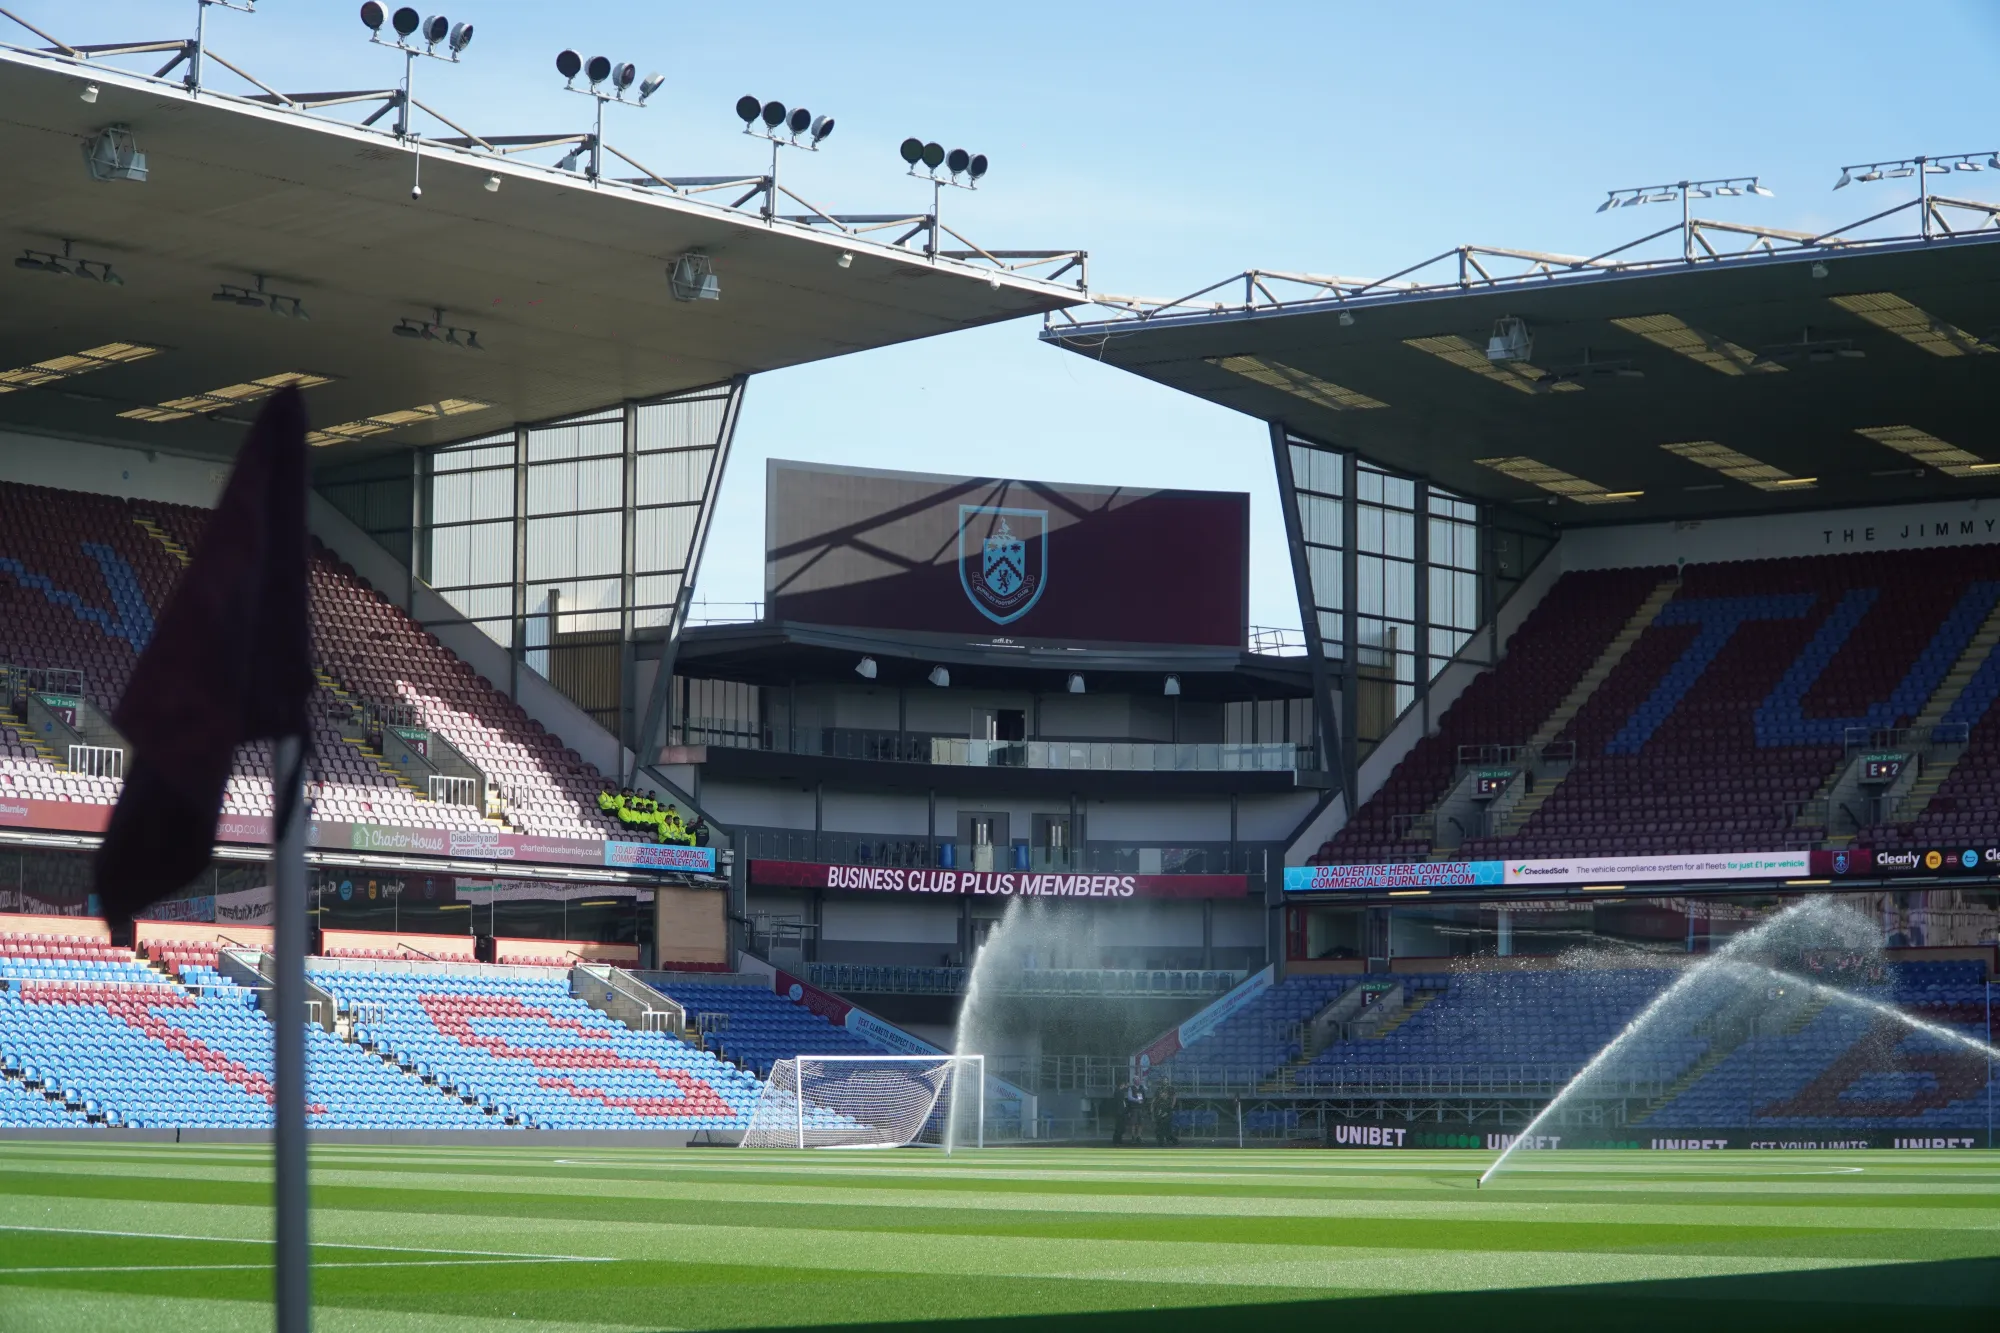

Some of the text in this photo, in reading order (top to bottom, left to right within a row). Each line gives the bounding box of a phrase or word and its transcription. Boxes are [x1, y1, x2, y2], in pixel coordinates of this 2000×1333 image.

[1823, 518, 1995, 544] THE JIMMY
[1017, 588, 1029, 598] CLUB
[65, 710, 72, 724] 7
[1871, 762, 1899, 776] E 2
[0, 804, 28, 816] Burnley
[371, 830, 444, 850] Charter House
[451, 833, 498, 844] Disability and
[451, 847, 485, 856] dementia
[485, 848, 498, 858] day
[520, 844, 602, 857] charterhouseburnley.co.uk
[614, 845, 707, 859] TO ADVERTISE HERE CONTACT:
[611, 854, 709, 869] COMMERCIAL@BURNLEYFC.COM
[1876, 851, 1921, 868] Clearly
[1315, 863, 1471, 877] TO ADVERTISE HERE CONTACT:
[1524, 867, 1569, 876] CheckedSafe
[1591, 865, 1616, 873] vehicle
[1617, 864, 1657, 874] compliance
[1658, 863, 1684, 873] system
[1695, 862, 1705, 870] all
[1705, 862, 1727, 870] fleets
[1728, 861, 1738, 869] for
[1739, 861, 1754, 870] just
[1755, 861, 1763, 869] £1
[1764, 861, 1776, 870] per
[1778, 860, 1805, 868] vehicle
[827, 866, 1136, 897] BUSINESS CLUB PLUS MEMBERS
[1311, 874, 1475, 889] COMMERCIAL@BURNLEYFC.COM
[857, 1016, 870, 1029] TEXT
[869, 1021, 889, 1038] CLARETS
[889, 1031, 909, 1047] RESPECT
[1336, 1125, 1407, 1147] UNIBET
[1487, 1133, 1561, 1150] UNIBET
